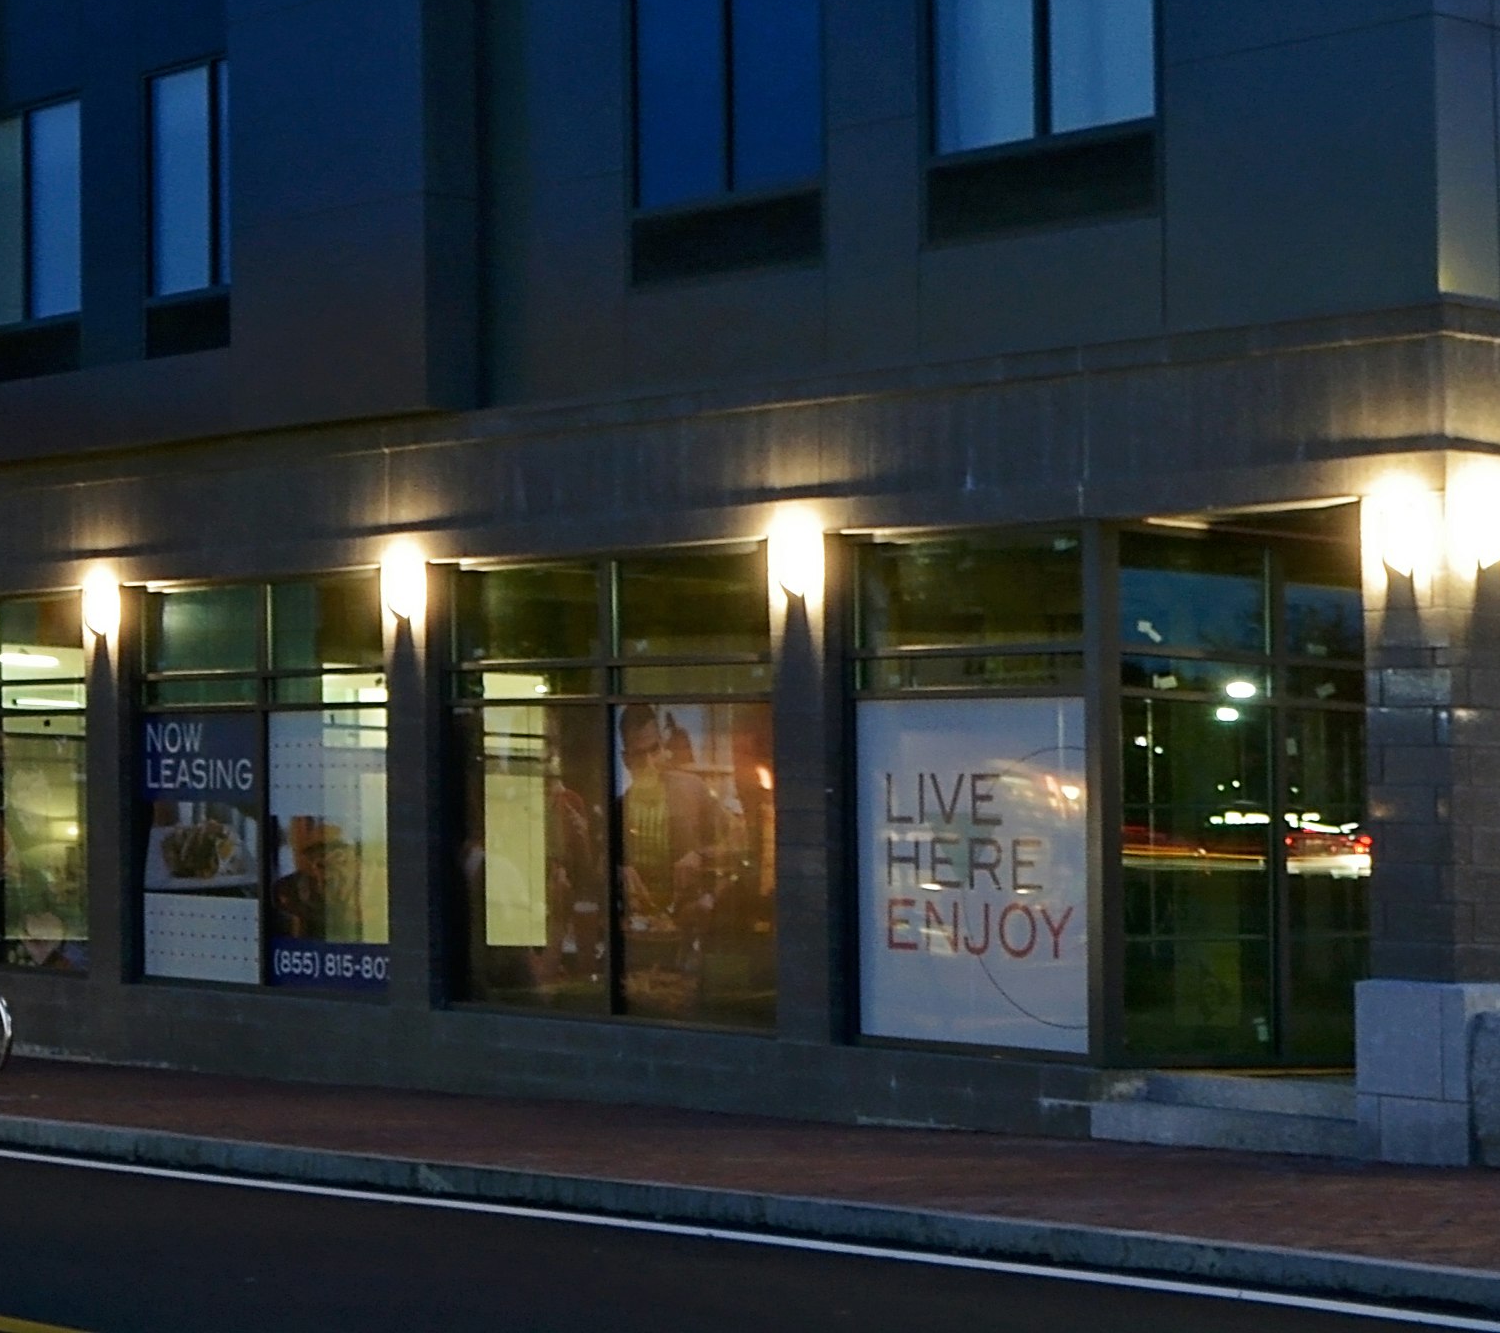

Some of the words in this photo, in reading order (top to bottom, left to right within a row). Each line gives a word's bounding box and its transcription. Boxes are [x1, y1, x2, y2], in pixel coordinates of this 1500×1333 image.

[145, 722, 203, 754] NOW
[145, 758, 254, 791] LEASING
[884, 771, 1004, 827] LIVE
[885, 836, 1044, 893] HERE
[885, 897, 1075, 961] ENJOY
[273, 947, 320, 979] (855)
[324, 951, 390, 982] 815-80
